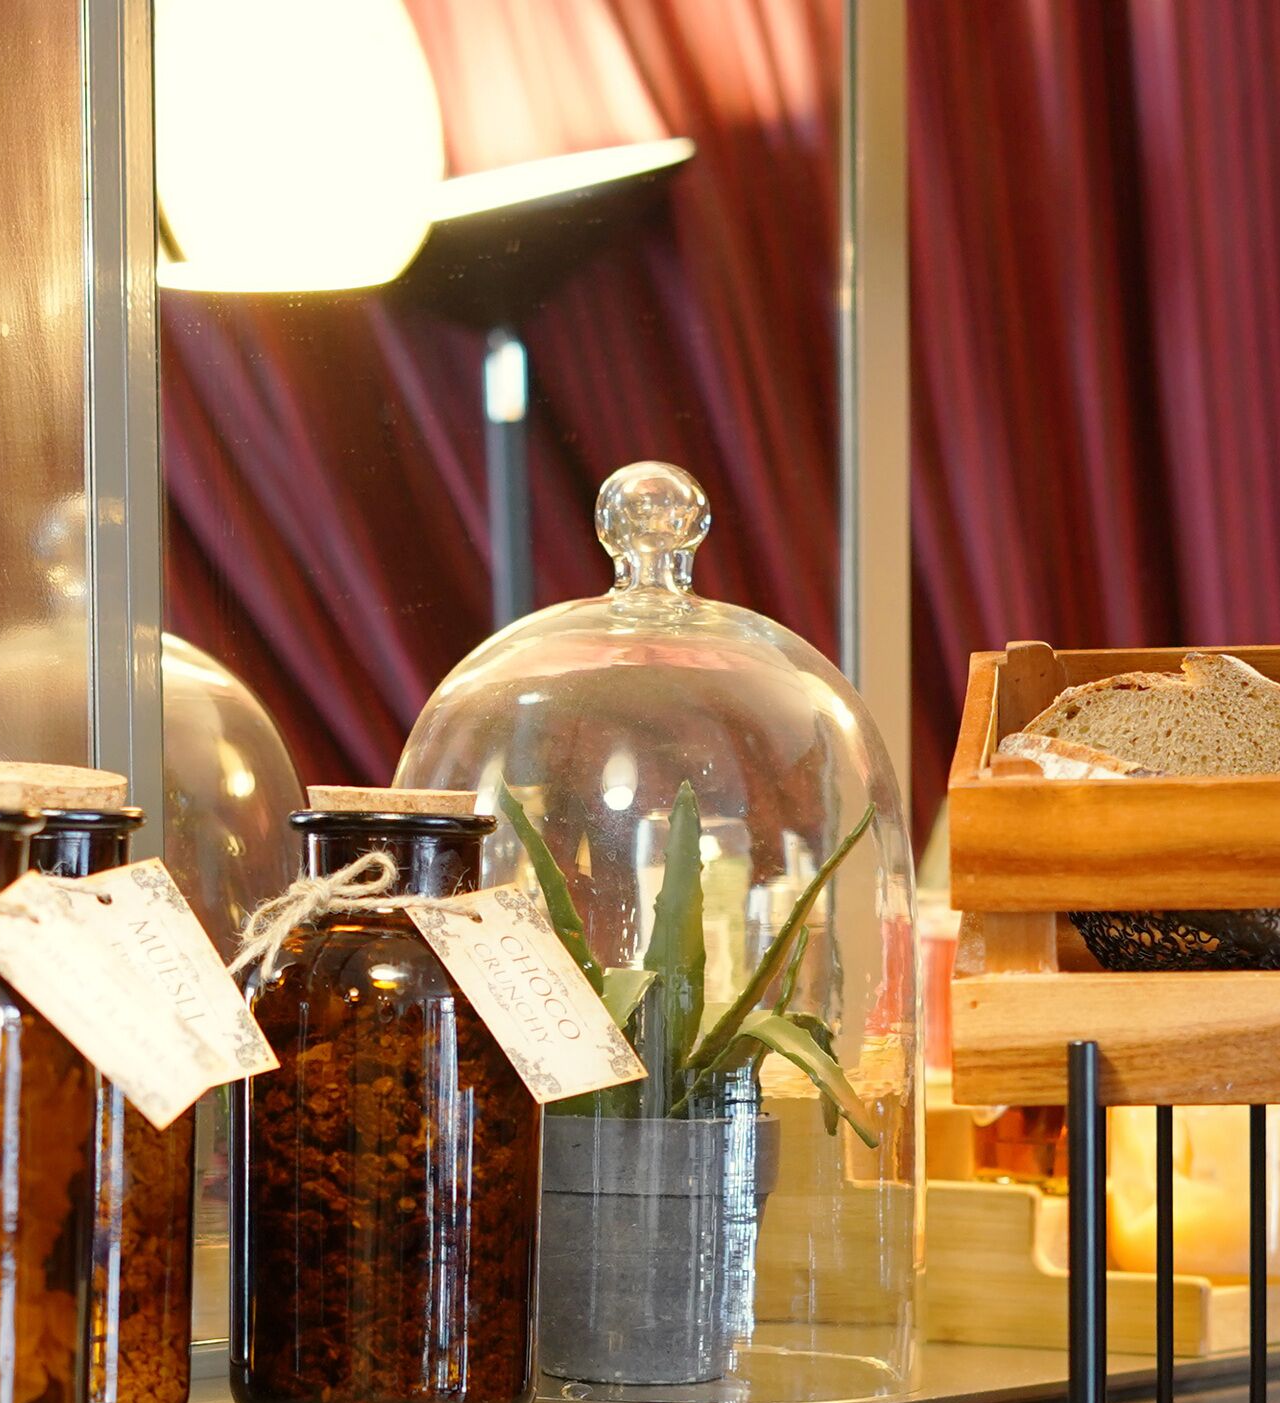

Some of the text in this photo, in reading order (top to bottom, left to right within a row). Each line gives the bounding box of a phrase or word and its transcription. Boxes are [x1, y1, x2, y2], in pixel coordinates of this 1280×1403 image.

[128, 919, 206, 1022] MUESLI
[473, 942, 554, 1045] CRUNCHY
[500, 935, 581, 1040] CHOCO
